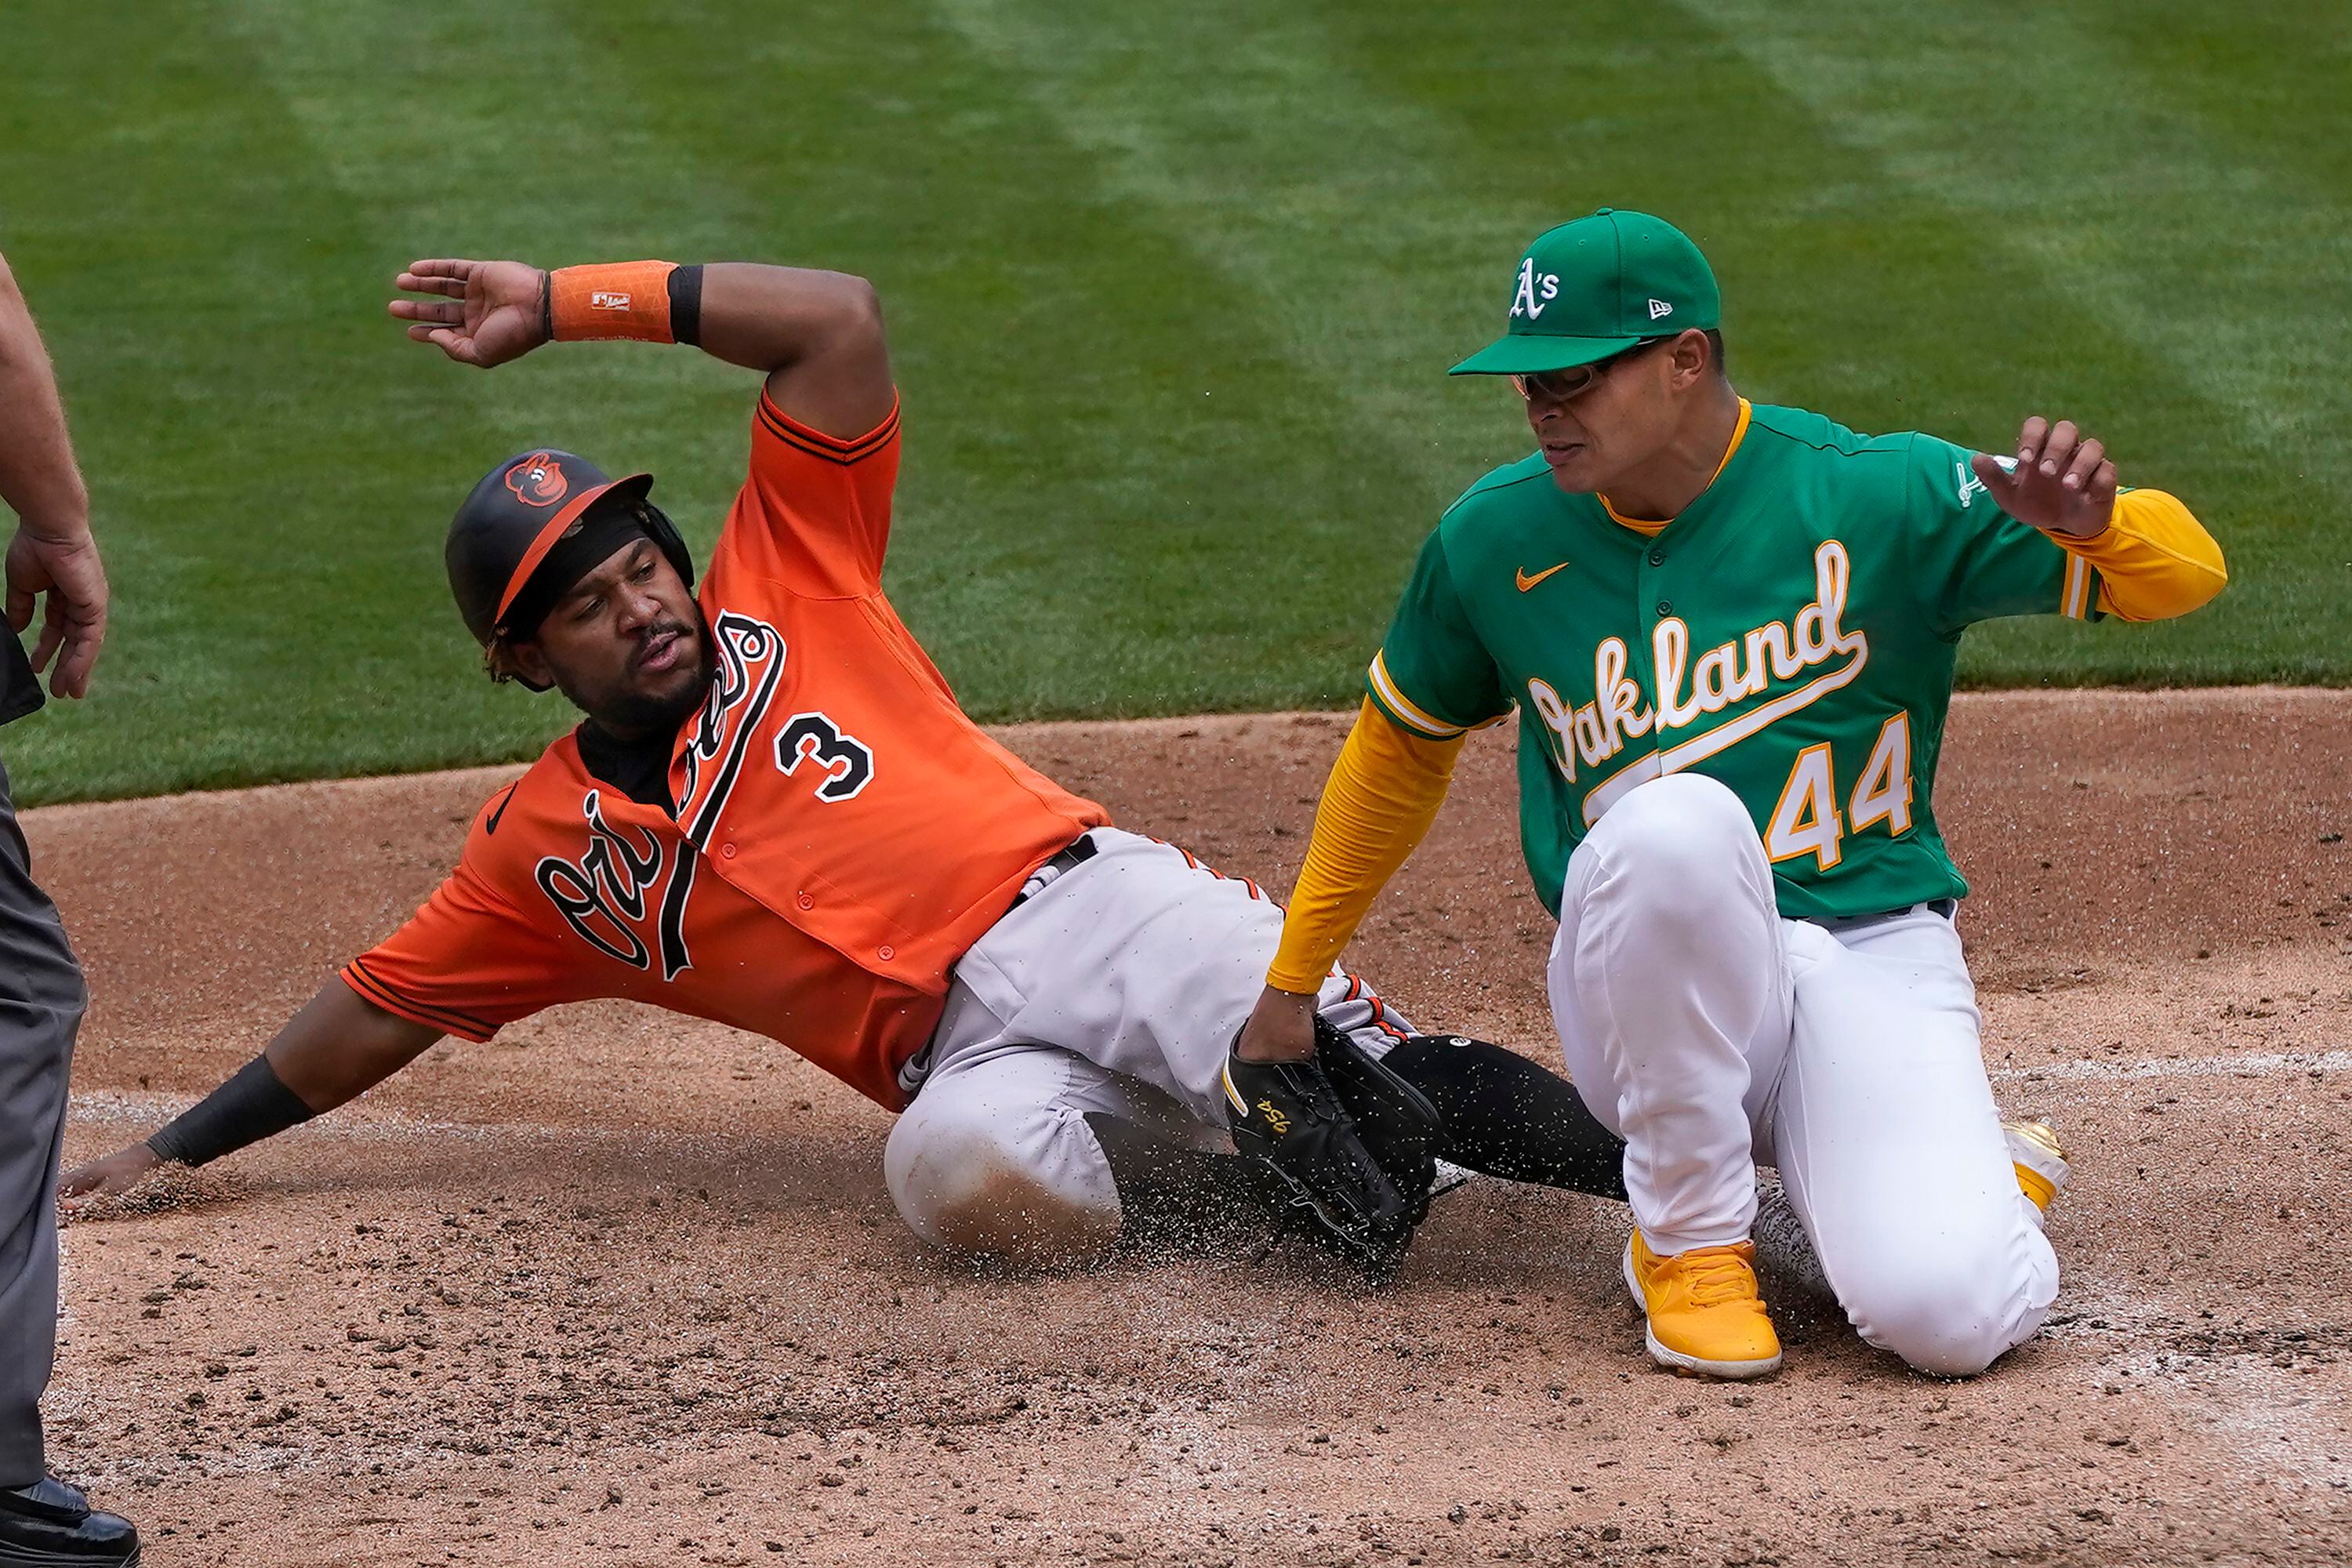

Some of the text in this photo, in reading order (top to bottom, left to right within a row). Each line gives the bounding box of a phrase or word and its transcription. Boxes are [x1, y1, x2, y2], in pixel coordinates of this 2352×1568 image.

[1509, 257, 1559, 320] A's
[1528, 539, 1868, 784] Oakland
[773, 711, 875, 804] 3
[1764, 709, 1915, 873] 44
[1257, 1099, 1292, 1134] 954
